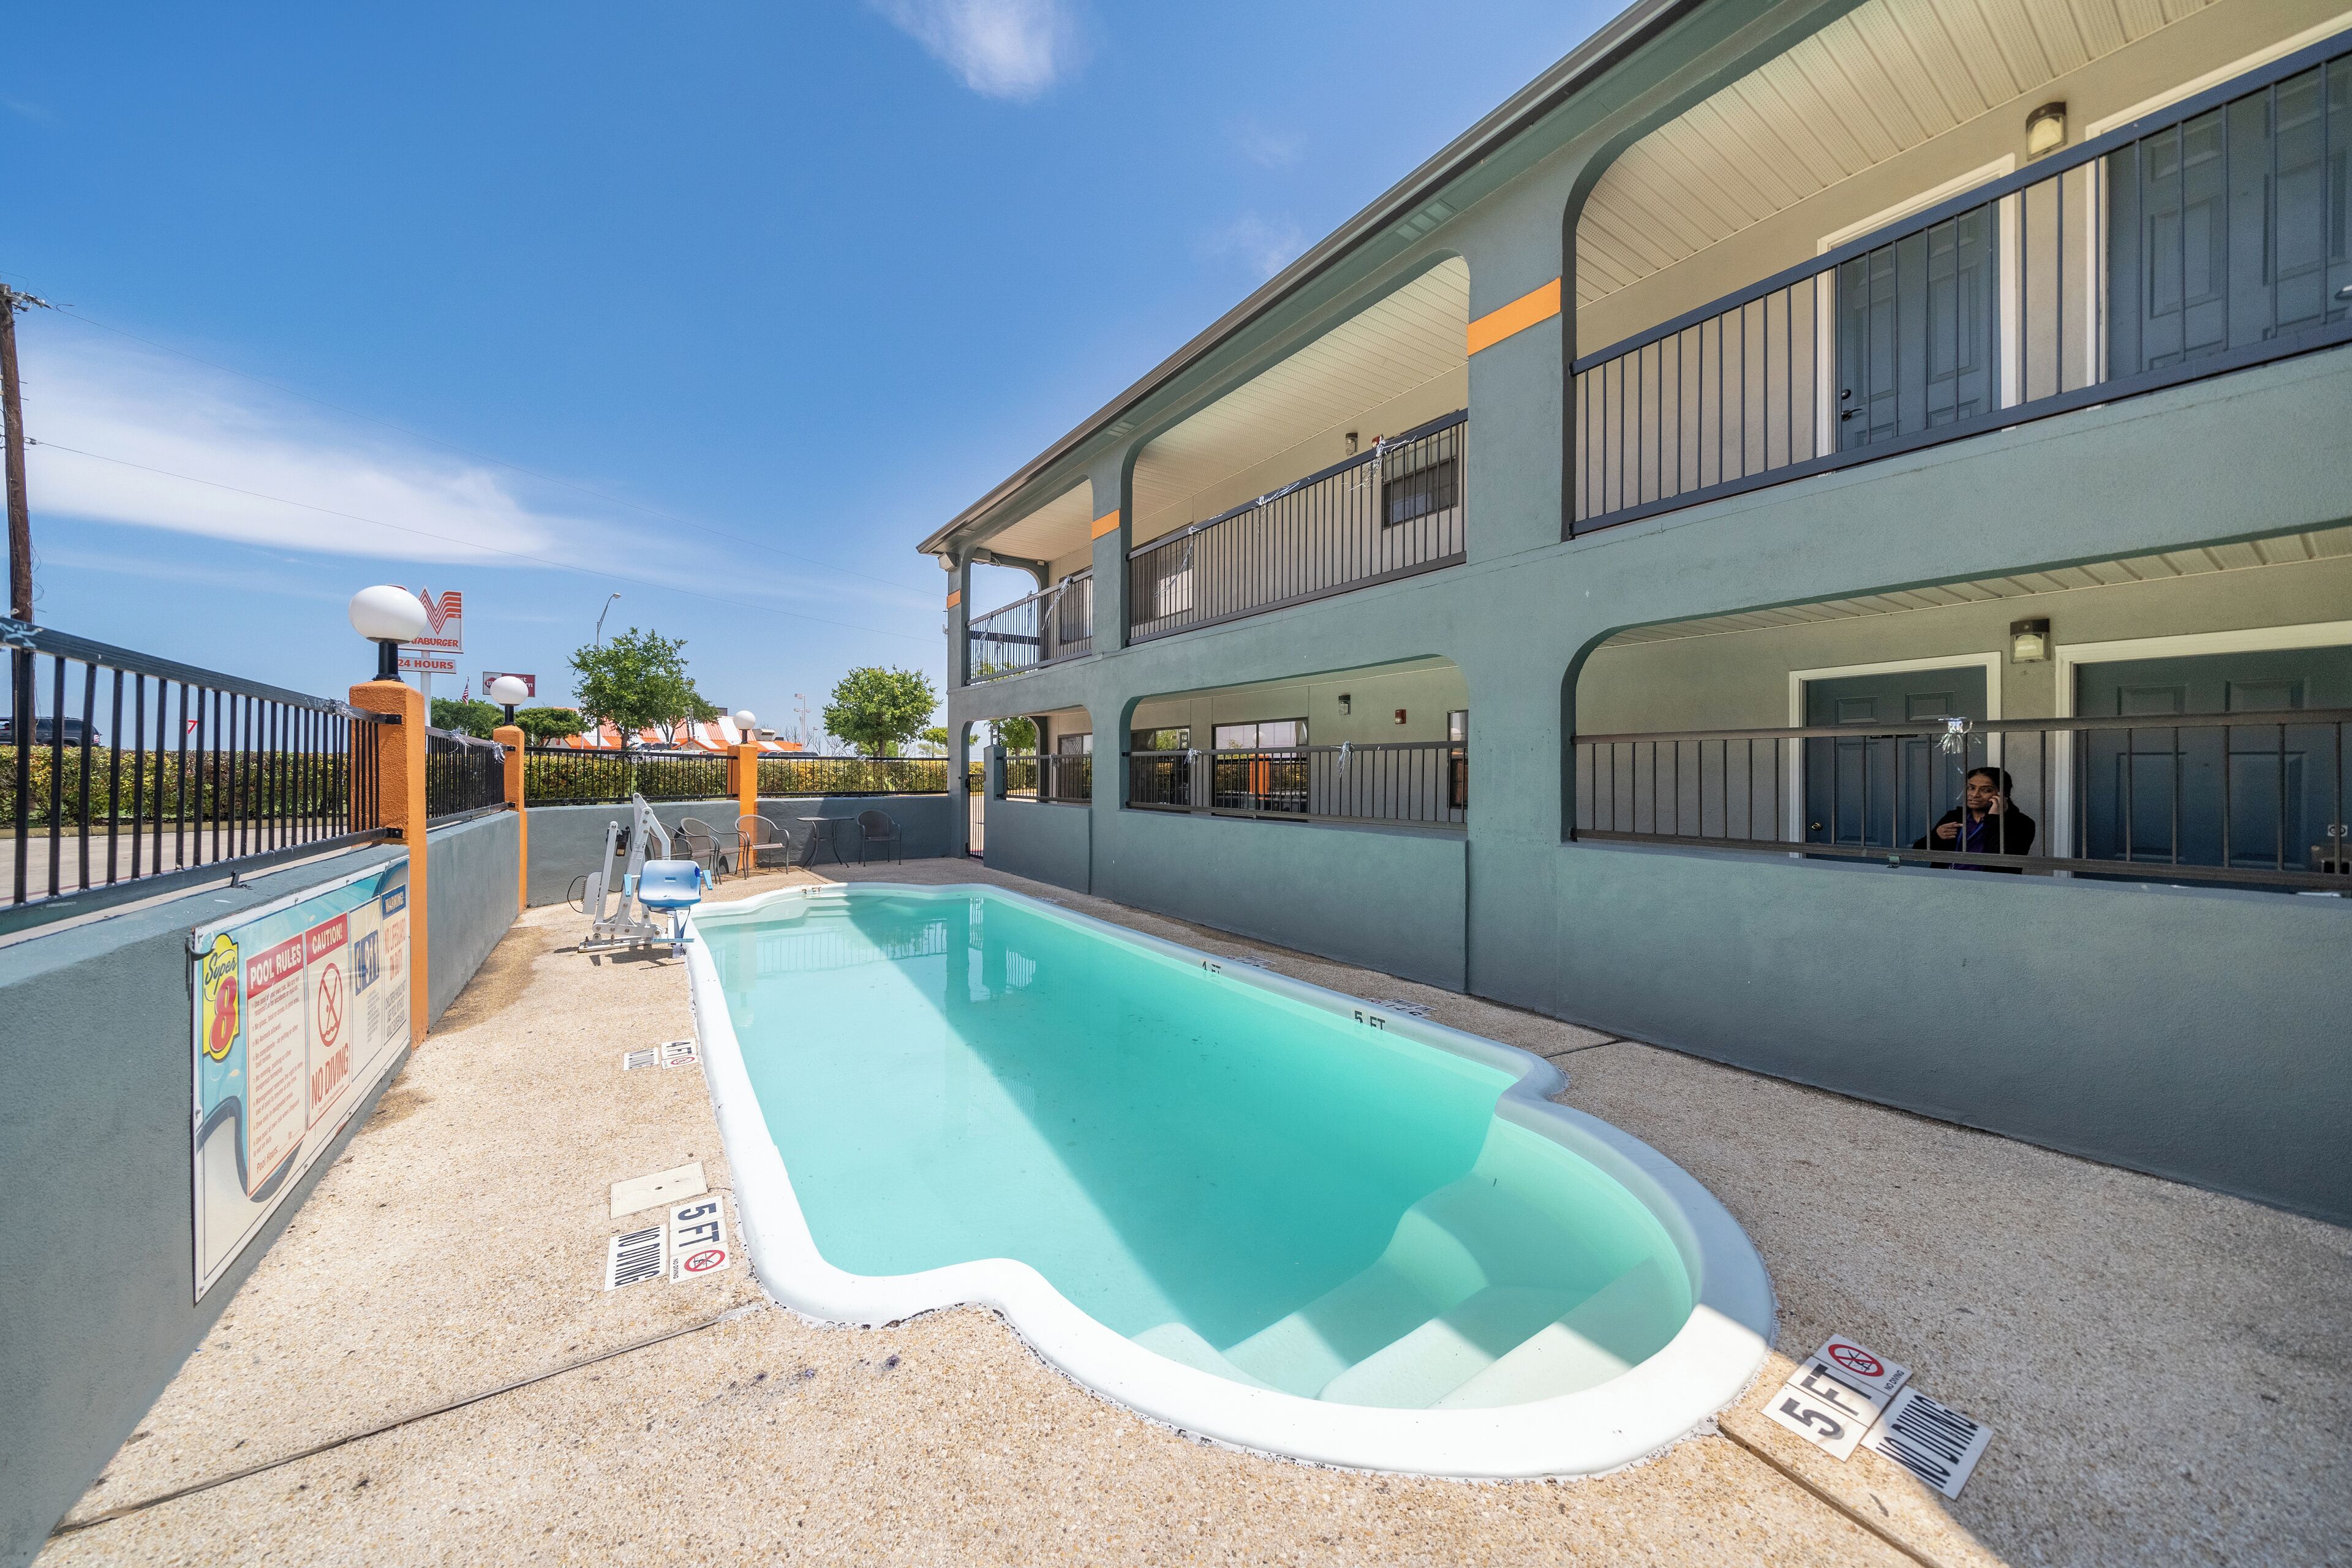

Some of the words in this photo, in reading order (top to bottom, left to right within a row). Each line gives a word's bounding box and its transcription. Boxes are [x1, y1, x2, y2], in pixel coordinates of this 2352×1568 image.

[414, 660, 454, 669] HOURS
[312, 922, 343, 955] CAUTION!
[364, 934, 379, 984] 911
[205, 952, 237, 995] Super
[250, 958, 274, 989] POOL
[276, 943, 302, 975] RULES
[209, 976, 237, 1052] 8
[1355, 1011, 1363, 1023] 5
[1370, 1016, 1385, 1030] FT
[667, 1047, 692, 1057] FT
[312, 1066, 323, 1110] NO
[325, 1042, 349, 1096] DIVING
[678, 1202, 717, 1221] 5
[617, 1227, 660, 1248] NO
[678, 1221, 720, 1248] FT
[614, 1242, 660, 1287] DIVING
[1800, 1363, 1872, 1417] FT
[1883, 1381, 1893, 1392] NO
[1891, 1370, 1905, 1385] DIVING
[1779, 1397, 1845, 1440] 5
[1891, 1394, 1979, 1465] DIVING
[1875, 1436, 1951, 1489] NO
